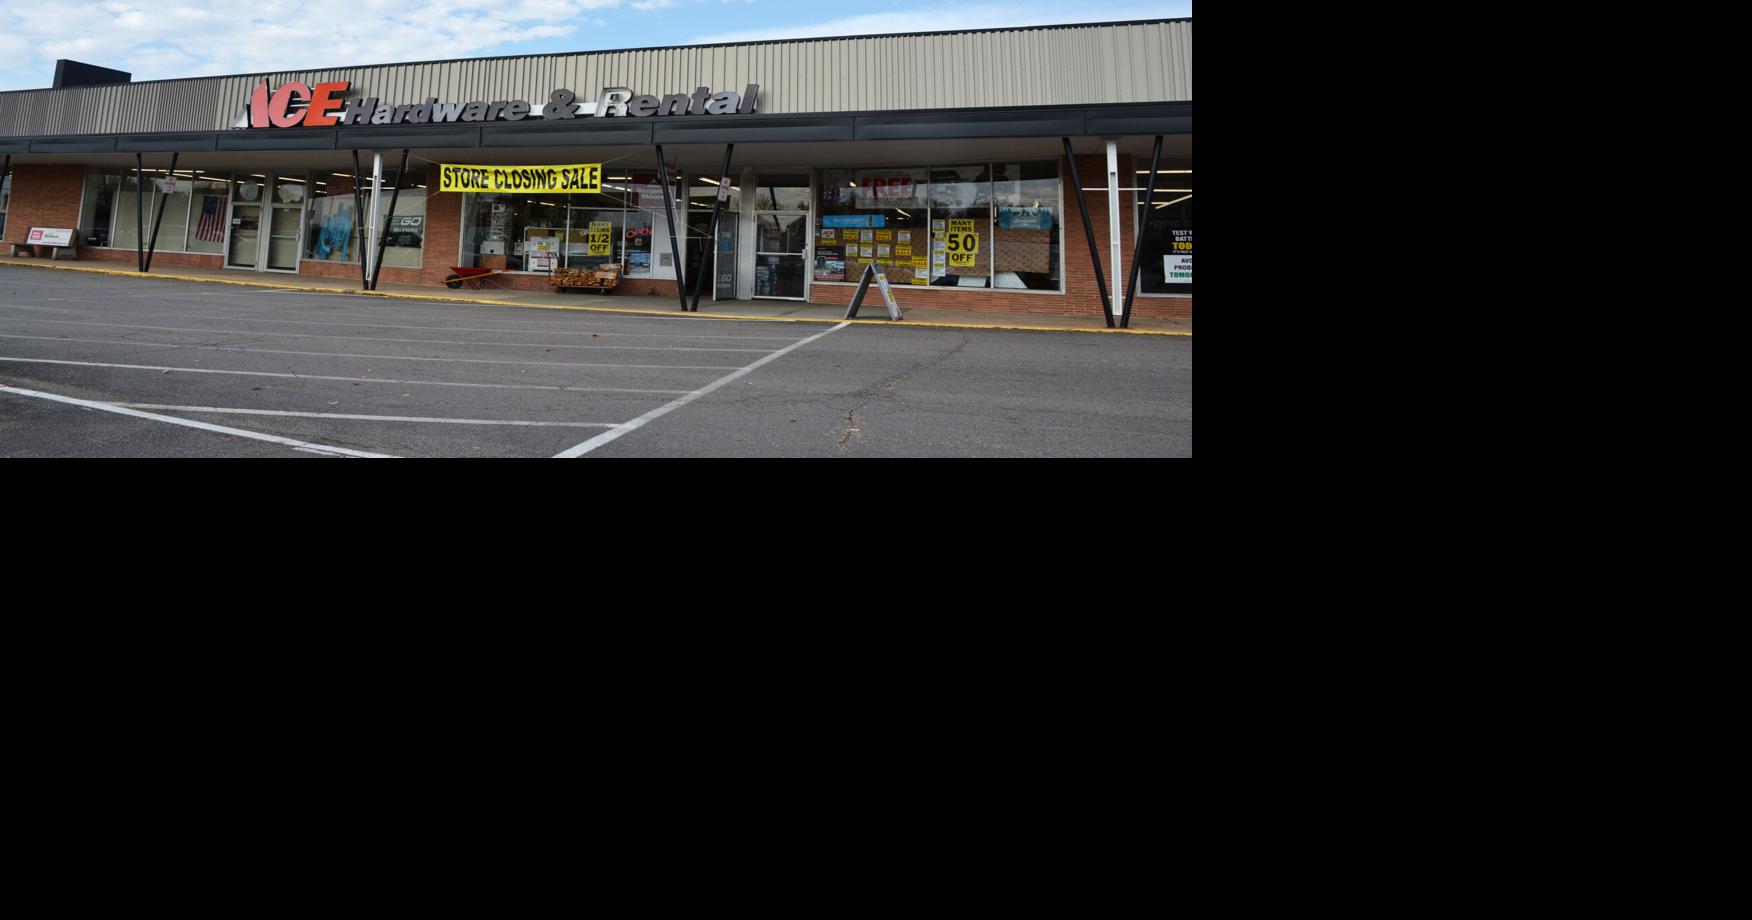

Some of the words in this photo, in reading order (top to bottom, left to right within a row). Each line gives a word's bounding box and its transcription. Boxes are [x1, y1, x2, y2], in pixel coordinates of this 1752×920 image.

[343, 97, 531, 125] Hardware
[543, 89, 577, 119] &
[595, 84, 760, 118] Rental
[443, 167, 489, 189] STORE
[494, 168, 557, 190] CLOSING
[561, 167, 599, 190] SALE
[590, 234, 609, 243] 1/2
[625, 228, 653, 238] OPEN
[947, 234, 976, 252] 50
[951, 253, 973, 261] OFF
